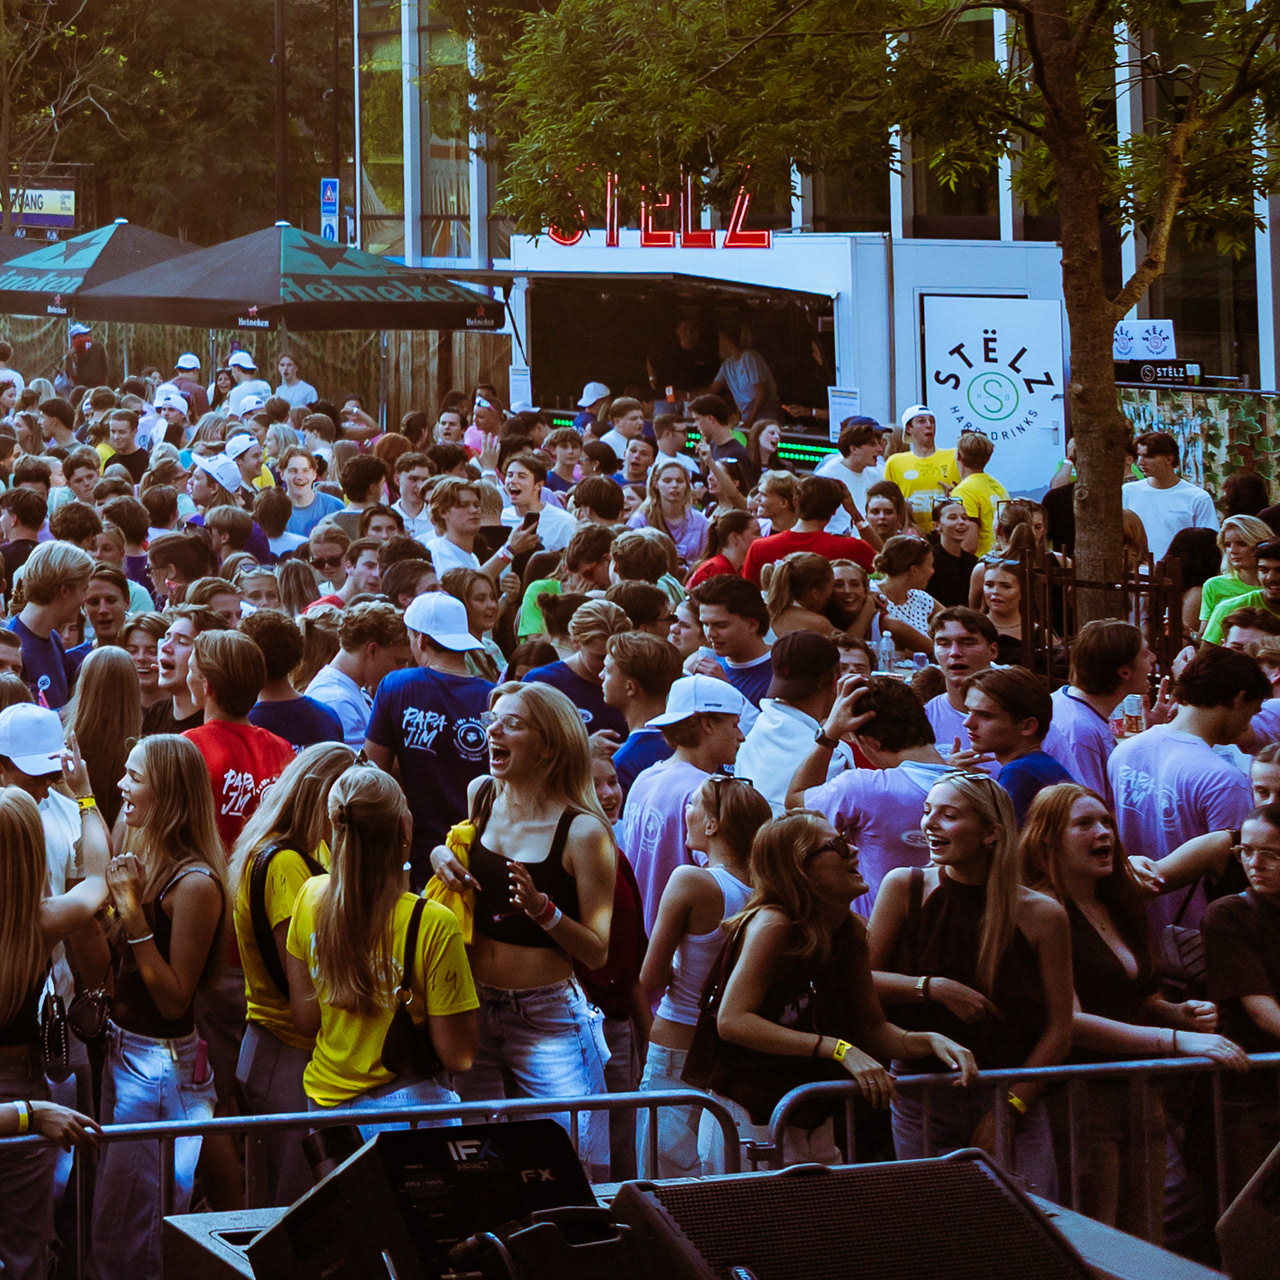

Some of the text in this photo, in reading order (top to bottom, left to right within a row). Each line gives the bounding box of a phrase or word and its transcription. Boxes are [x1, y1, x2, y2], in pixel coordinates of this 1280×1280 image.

[237, 317, 269, 327] Heineken
[933, 328, 1056, 395] STËLZ
[1156, 365, 1185, 377] STËLZ
[990, 409, 1039, 441] DRINKS
[400, 706, 447, 732] PAPA
[221, 768, 254, 796] PAPA
